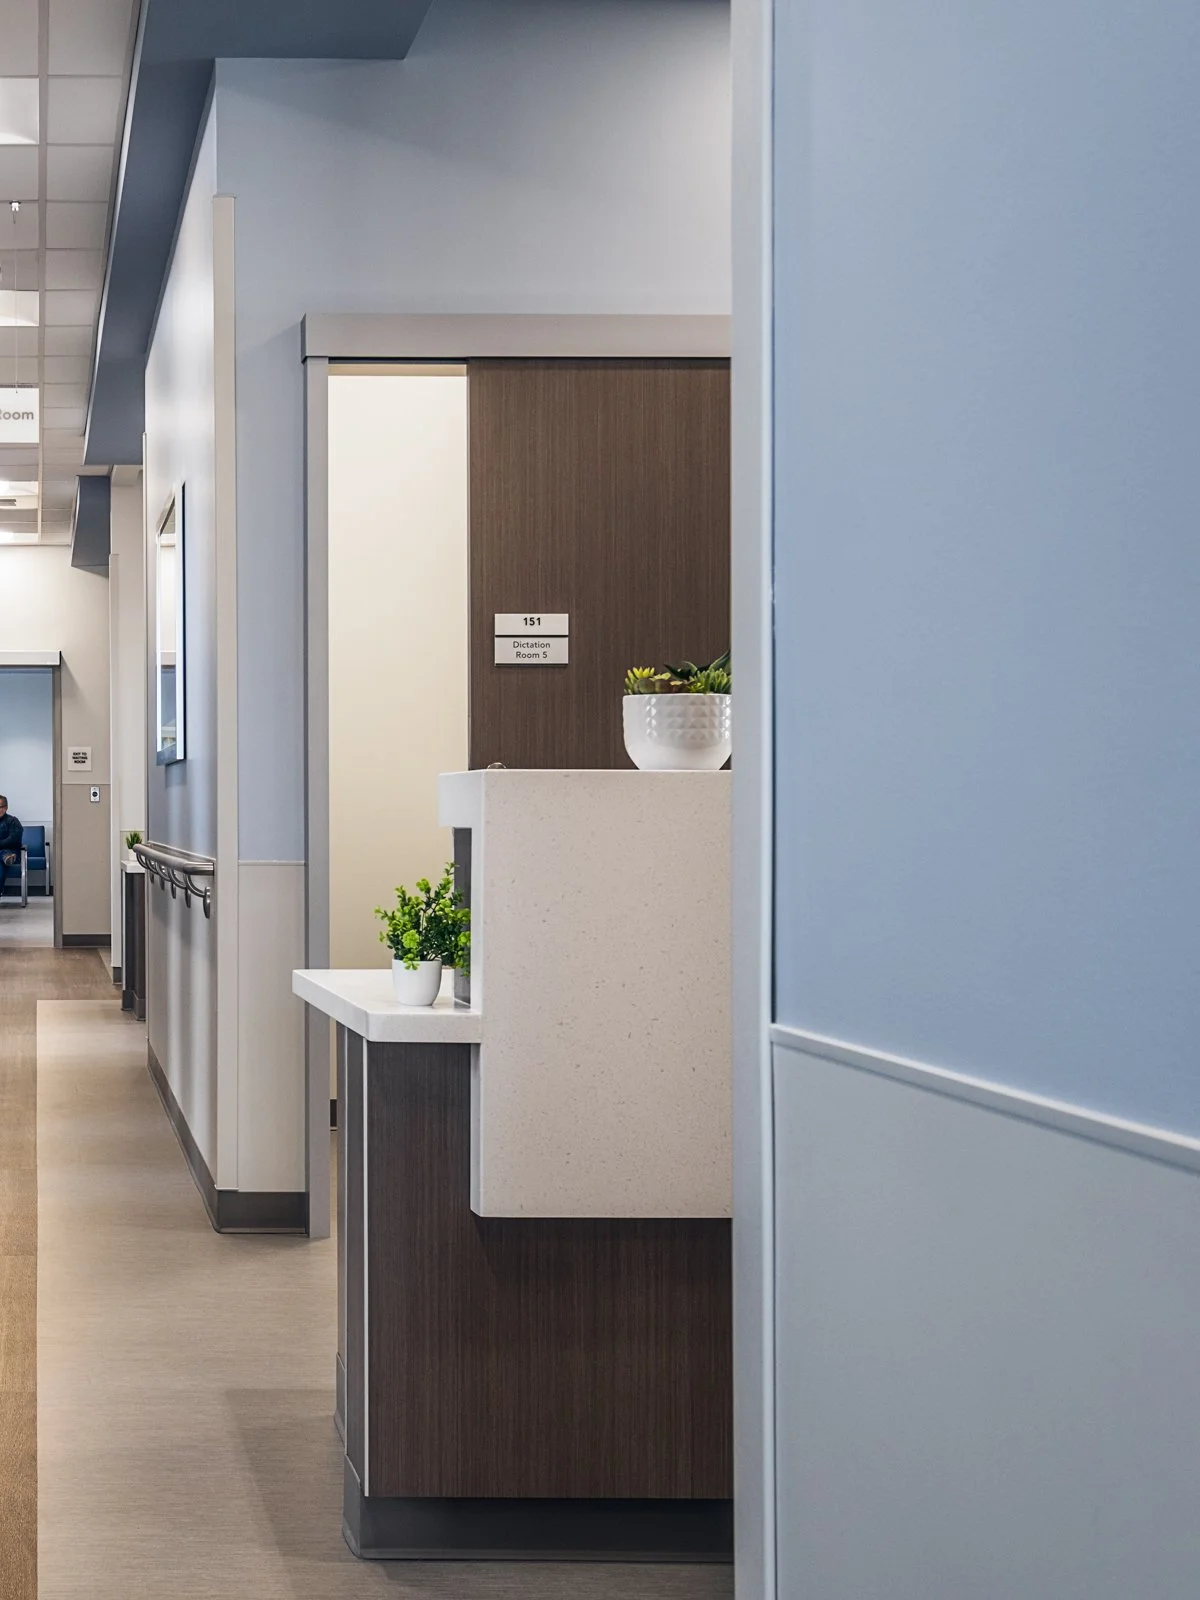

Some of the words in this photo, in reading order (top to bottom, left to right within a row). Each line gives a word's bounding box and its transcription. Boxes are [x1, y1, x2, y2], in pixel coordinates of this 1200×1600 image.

[523, 616, 542, 627] 151
[512, 640, 551, 649] Dictation
[515, 651, 540, 659] Room
[542, 651, 548, 659] 5
